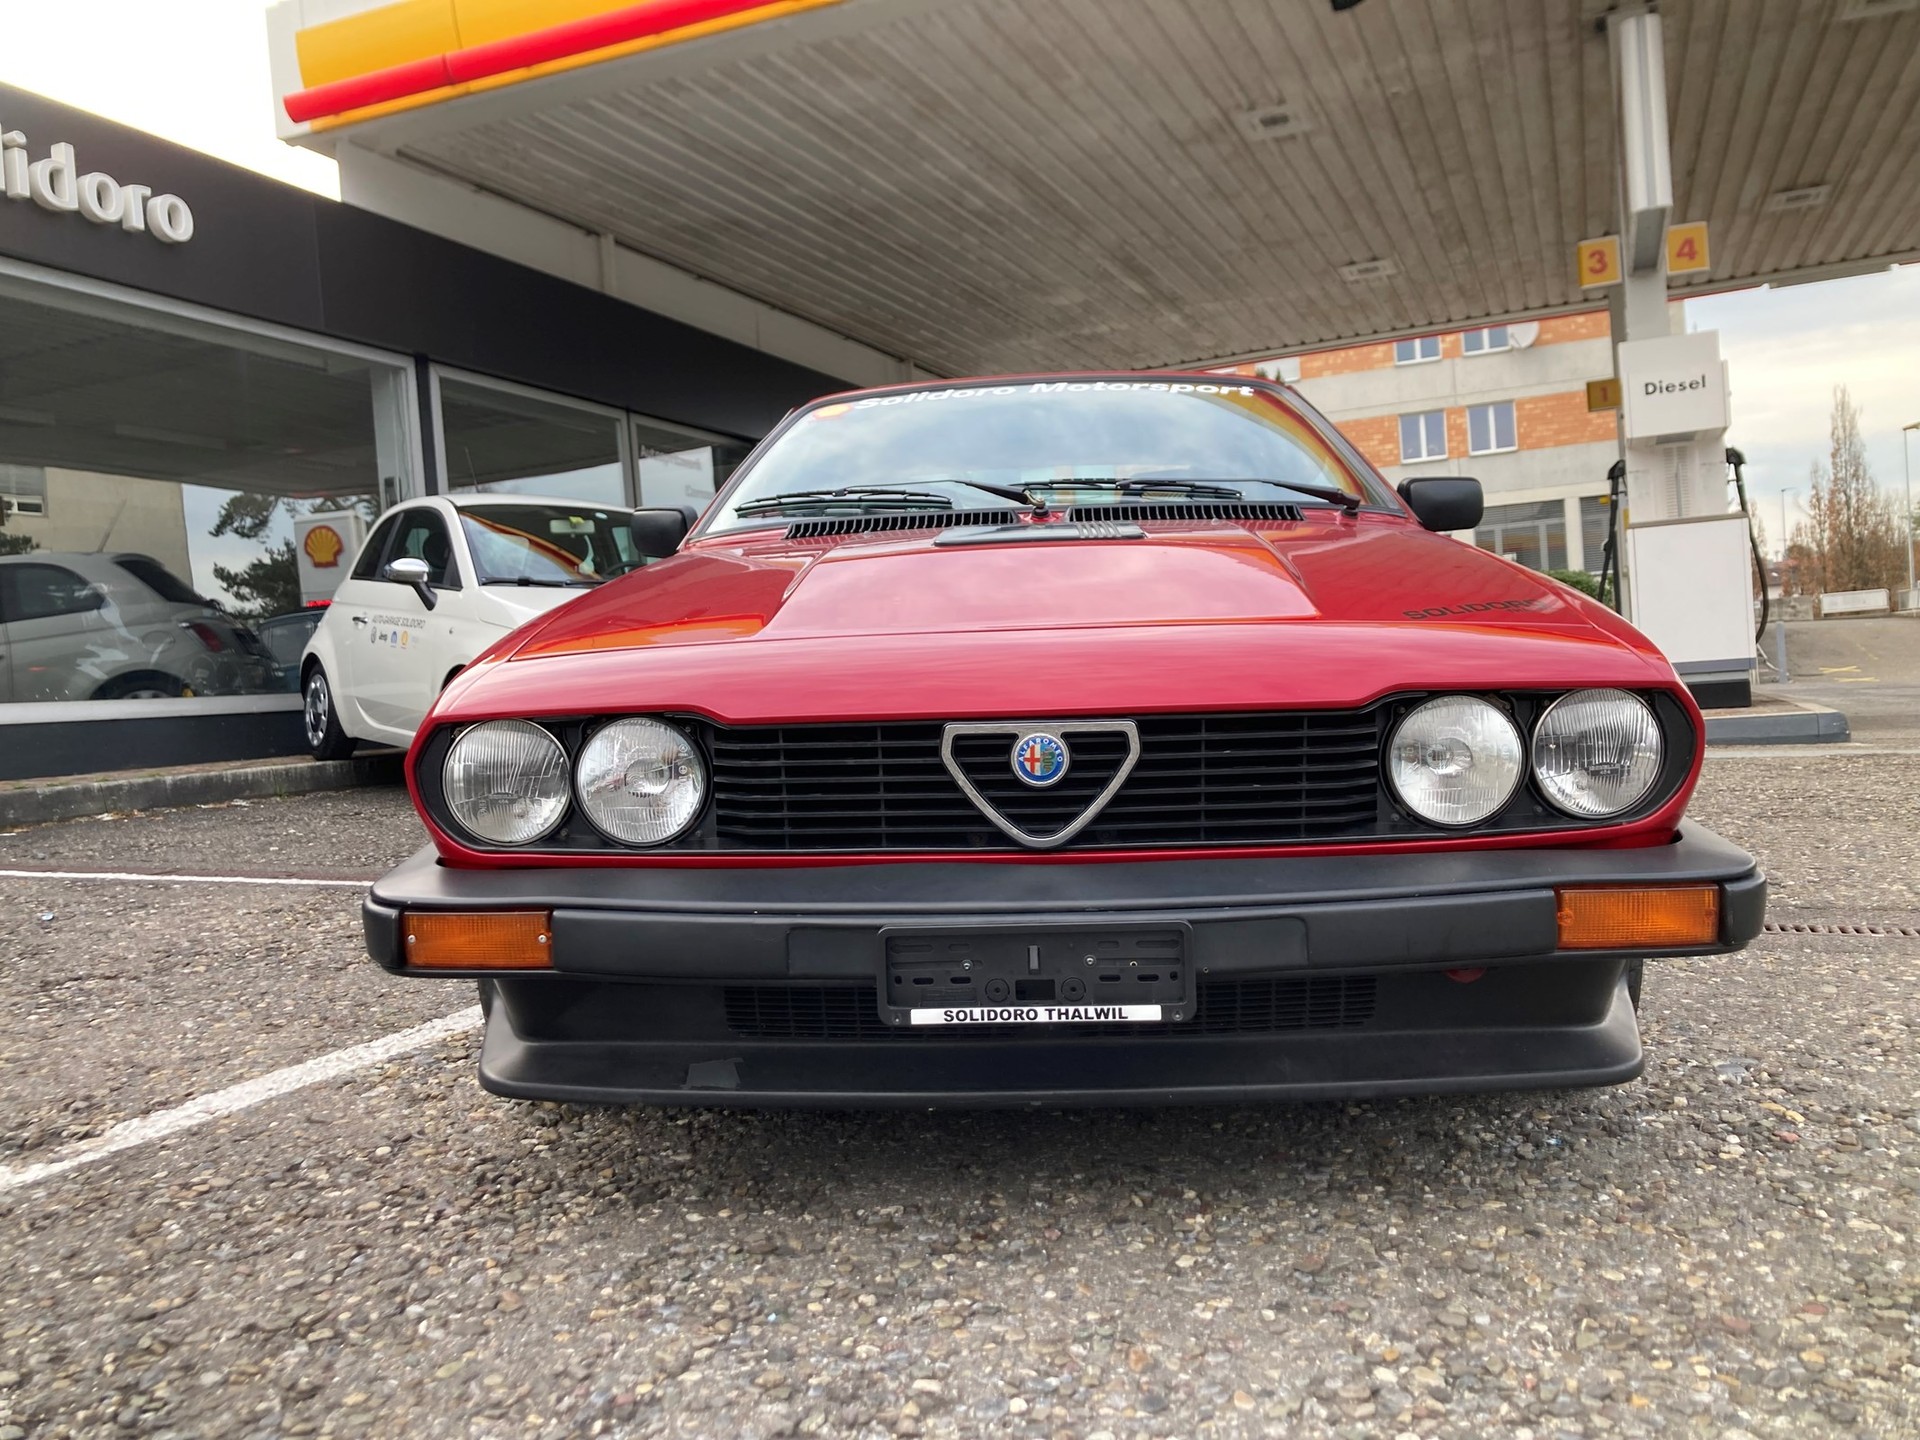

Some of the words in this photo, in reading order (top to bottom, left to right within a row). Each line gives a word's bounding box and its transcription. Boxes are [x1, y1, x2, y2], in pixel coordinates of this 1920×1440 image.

[1676, 238, 1698, 261] 4
[1589, 250, 1608, 274] 3
[855, 386, 1017, 409] Solidoro
[1029, 381, 1255, 396] Motorsport
[1644, 374, 1707, 396] Diesel
[943, 1008, 1038, 1022] SOLIDORO
[1045, 1007, 1129, 1021] THALWIL
